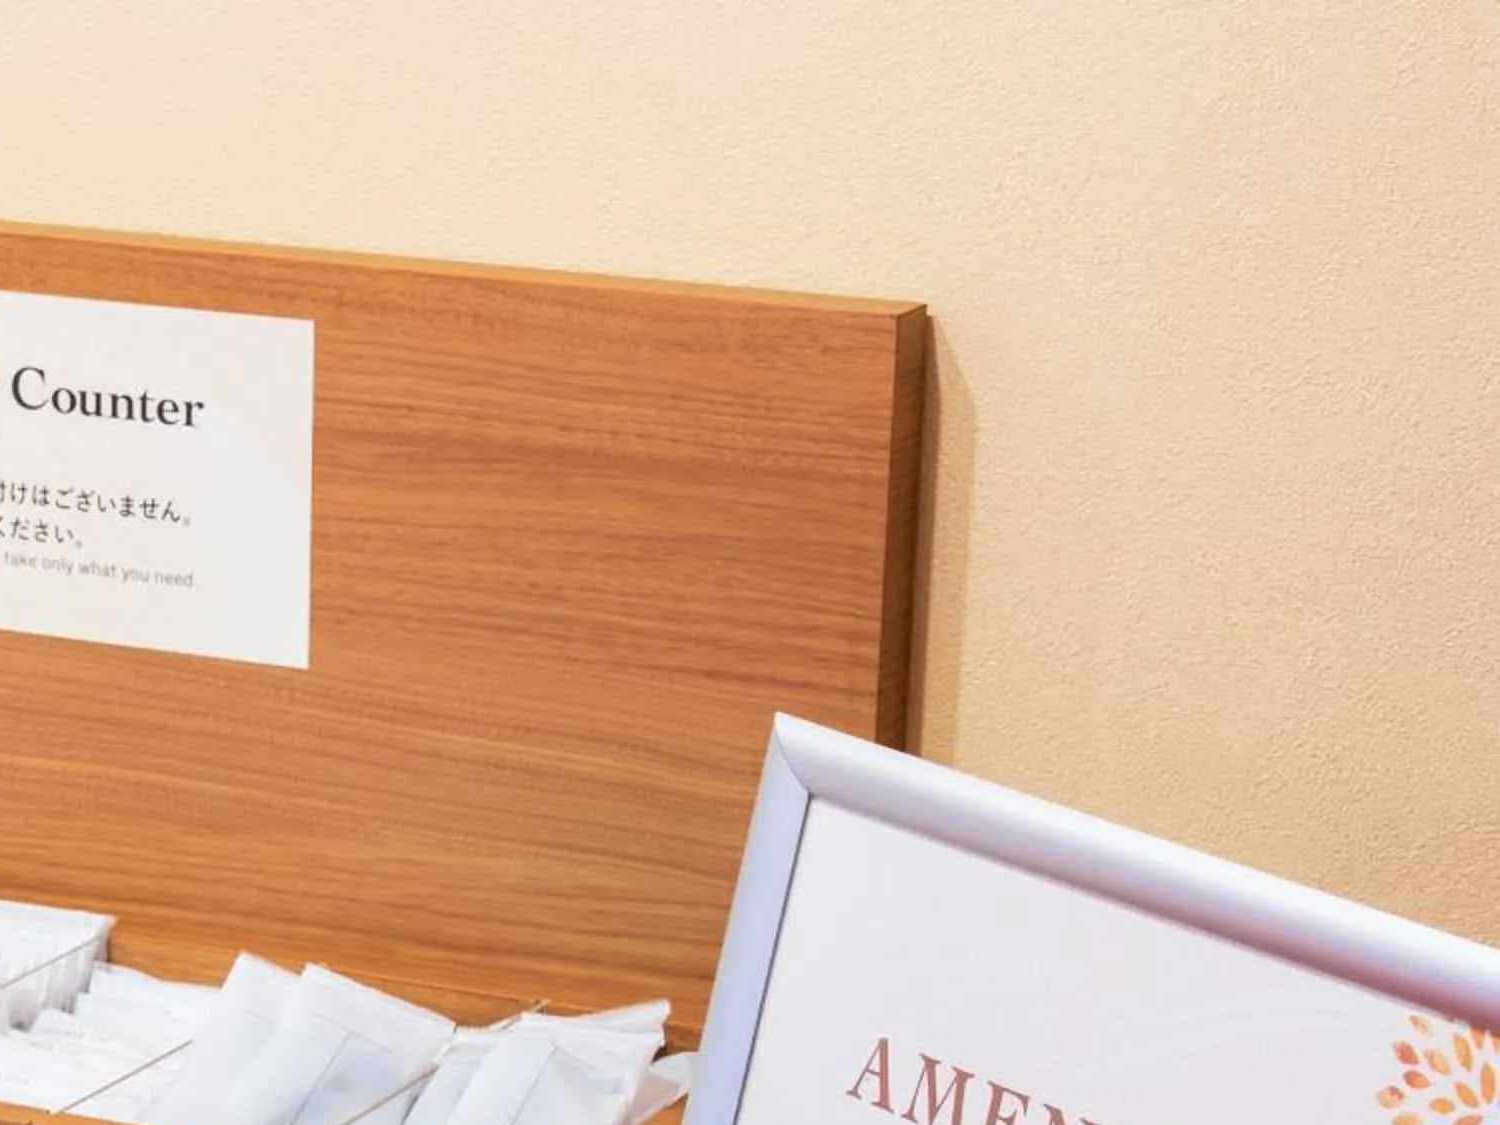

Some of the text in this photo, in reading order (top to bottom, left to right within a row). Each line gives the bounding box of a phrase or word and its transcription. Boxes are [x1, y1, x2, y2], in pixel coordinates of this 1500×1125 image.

[11, 366, 205, 428] Counter
[3, 550, 38, 570] take
[41, 556, 75, 576] only
[77, 560, 118, 579] what
[121, 570, 150, 583] you
